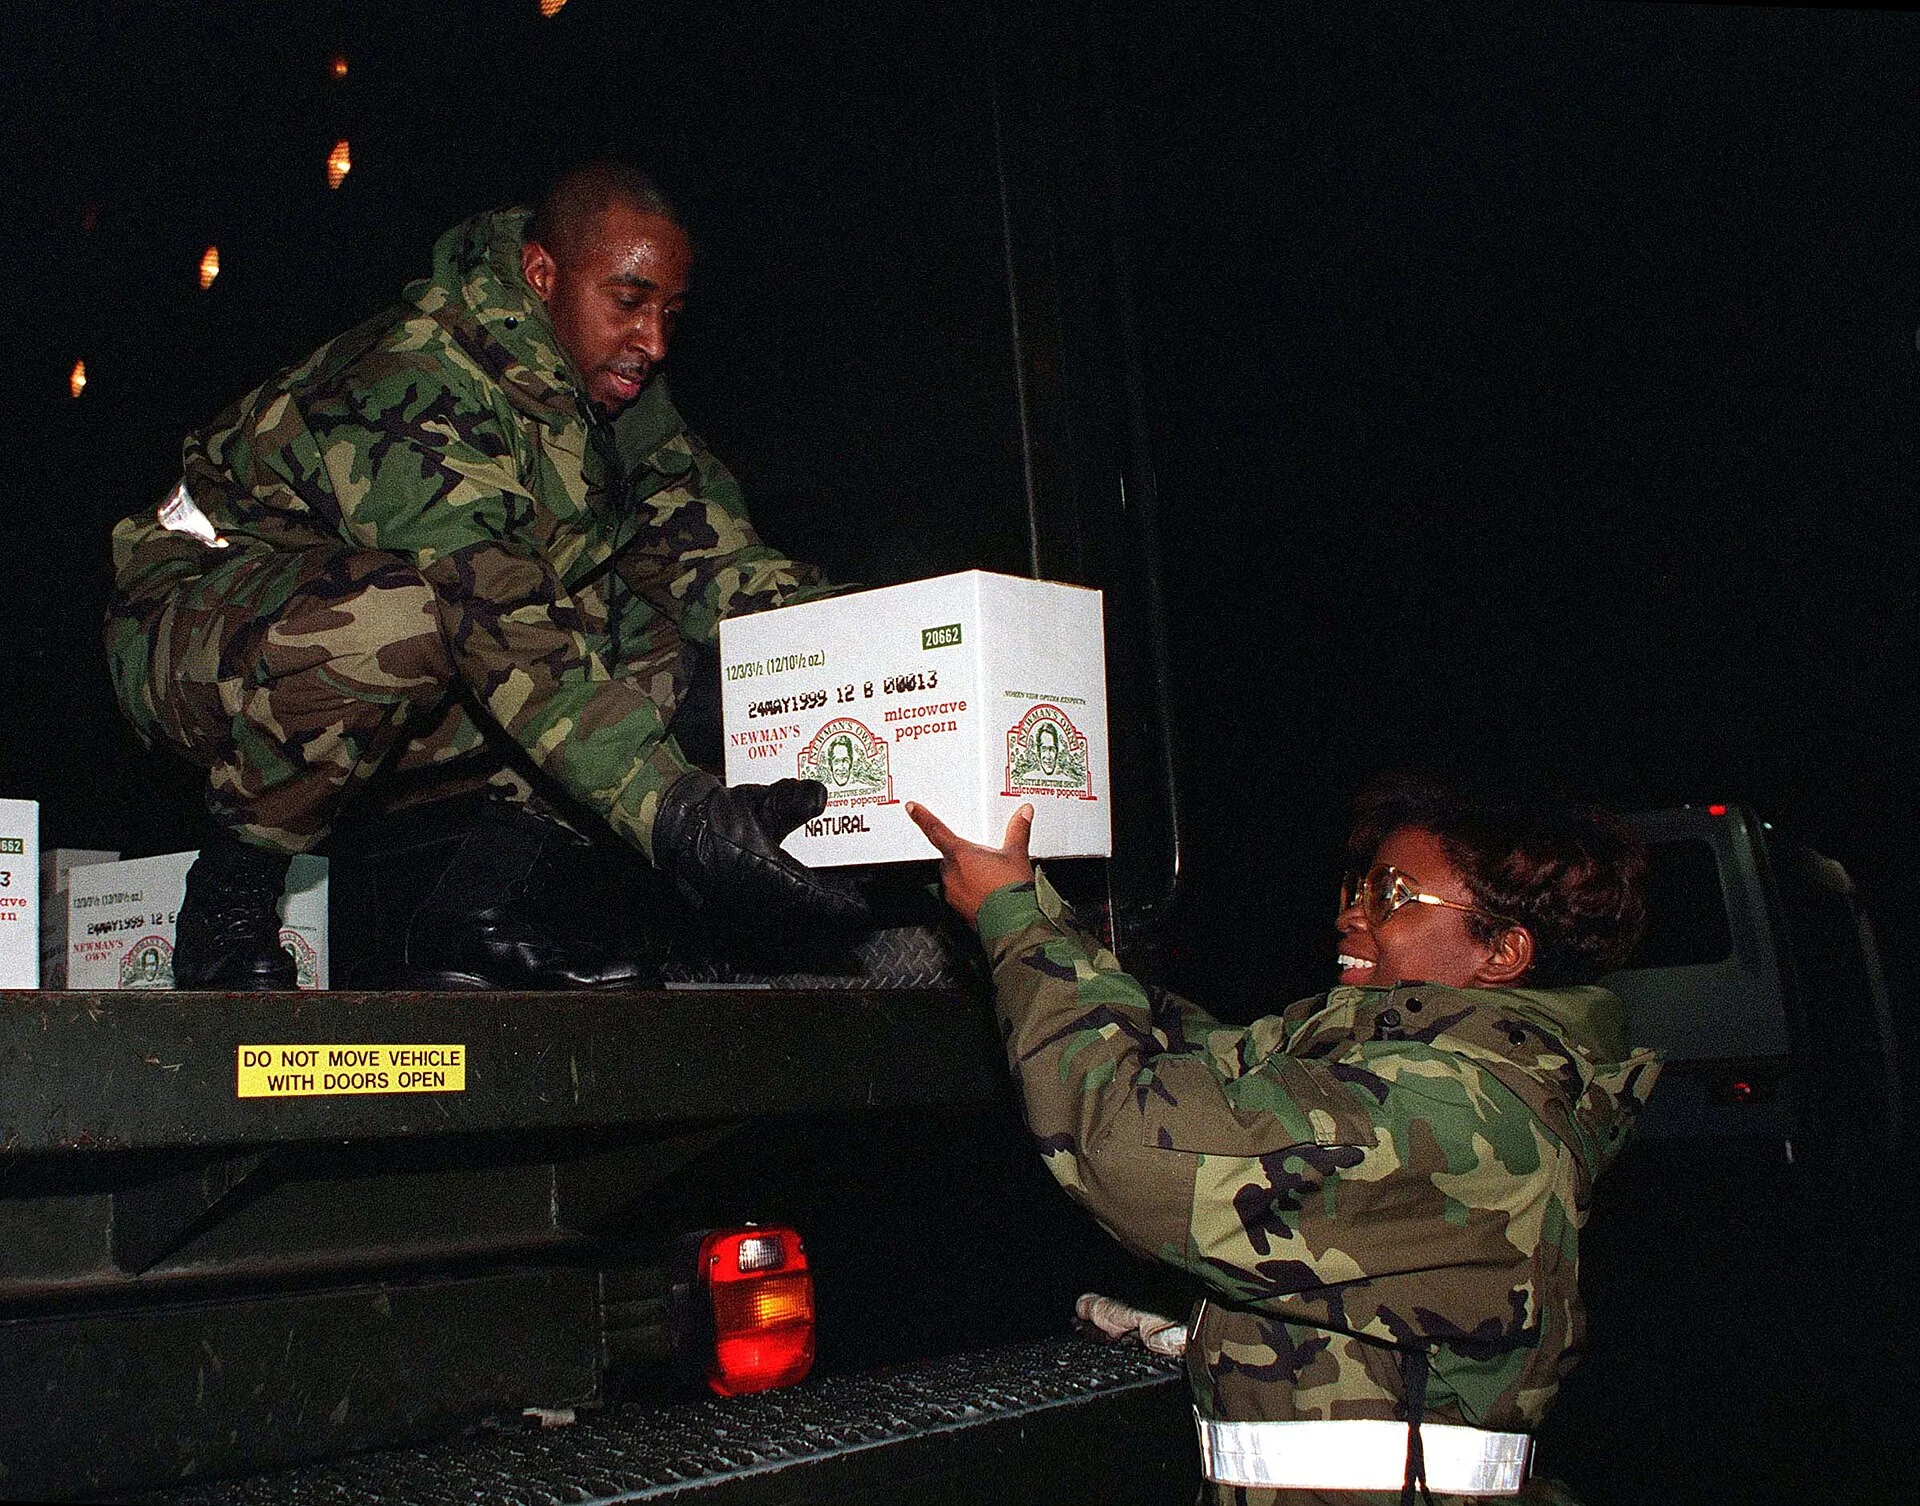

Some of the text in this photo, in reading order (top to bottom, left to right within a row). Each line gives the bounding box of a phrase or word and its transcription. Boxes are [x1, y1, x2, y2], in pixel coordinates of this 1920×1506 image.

[925, 627, 959, 647] 20662
[837, 684, 854, 703] 12
[884, 700, 967, 722] microwave
[731, 725, 801, 747] NEWMAN'S
[809, 721, 853, 760] NEWMAN'S
[895, 720, 957, 742] popcorn
[850, 795, 887, 808] popcorn
[1011, 785, 1087, 799] microwave popcorn
[805, 815, 870, 837] NATURAL
[0, 840, 21, 852] 662
[151, 912, 163, 925] 12
[243, 1050, 461, 1067] DO NOT MOVE VEHICLE
[267, 1072, 445, 1091] WITH DOORS OPEN
